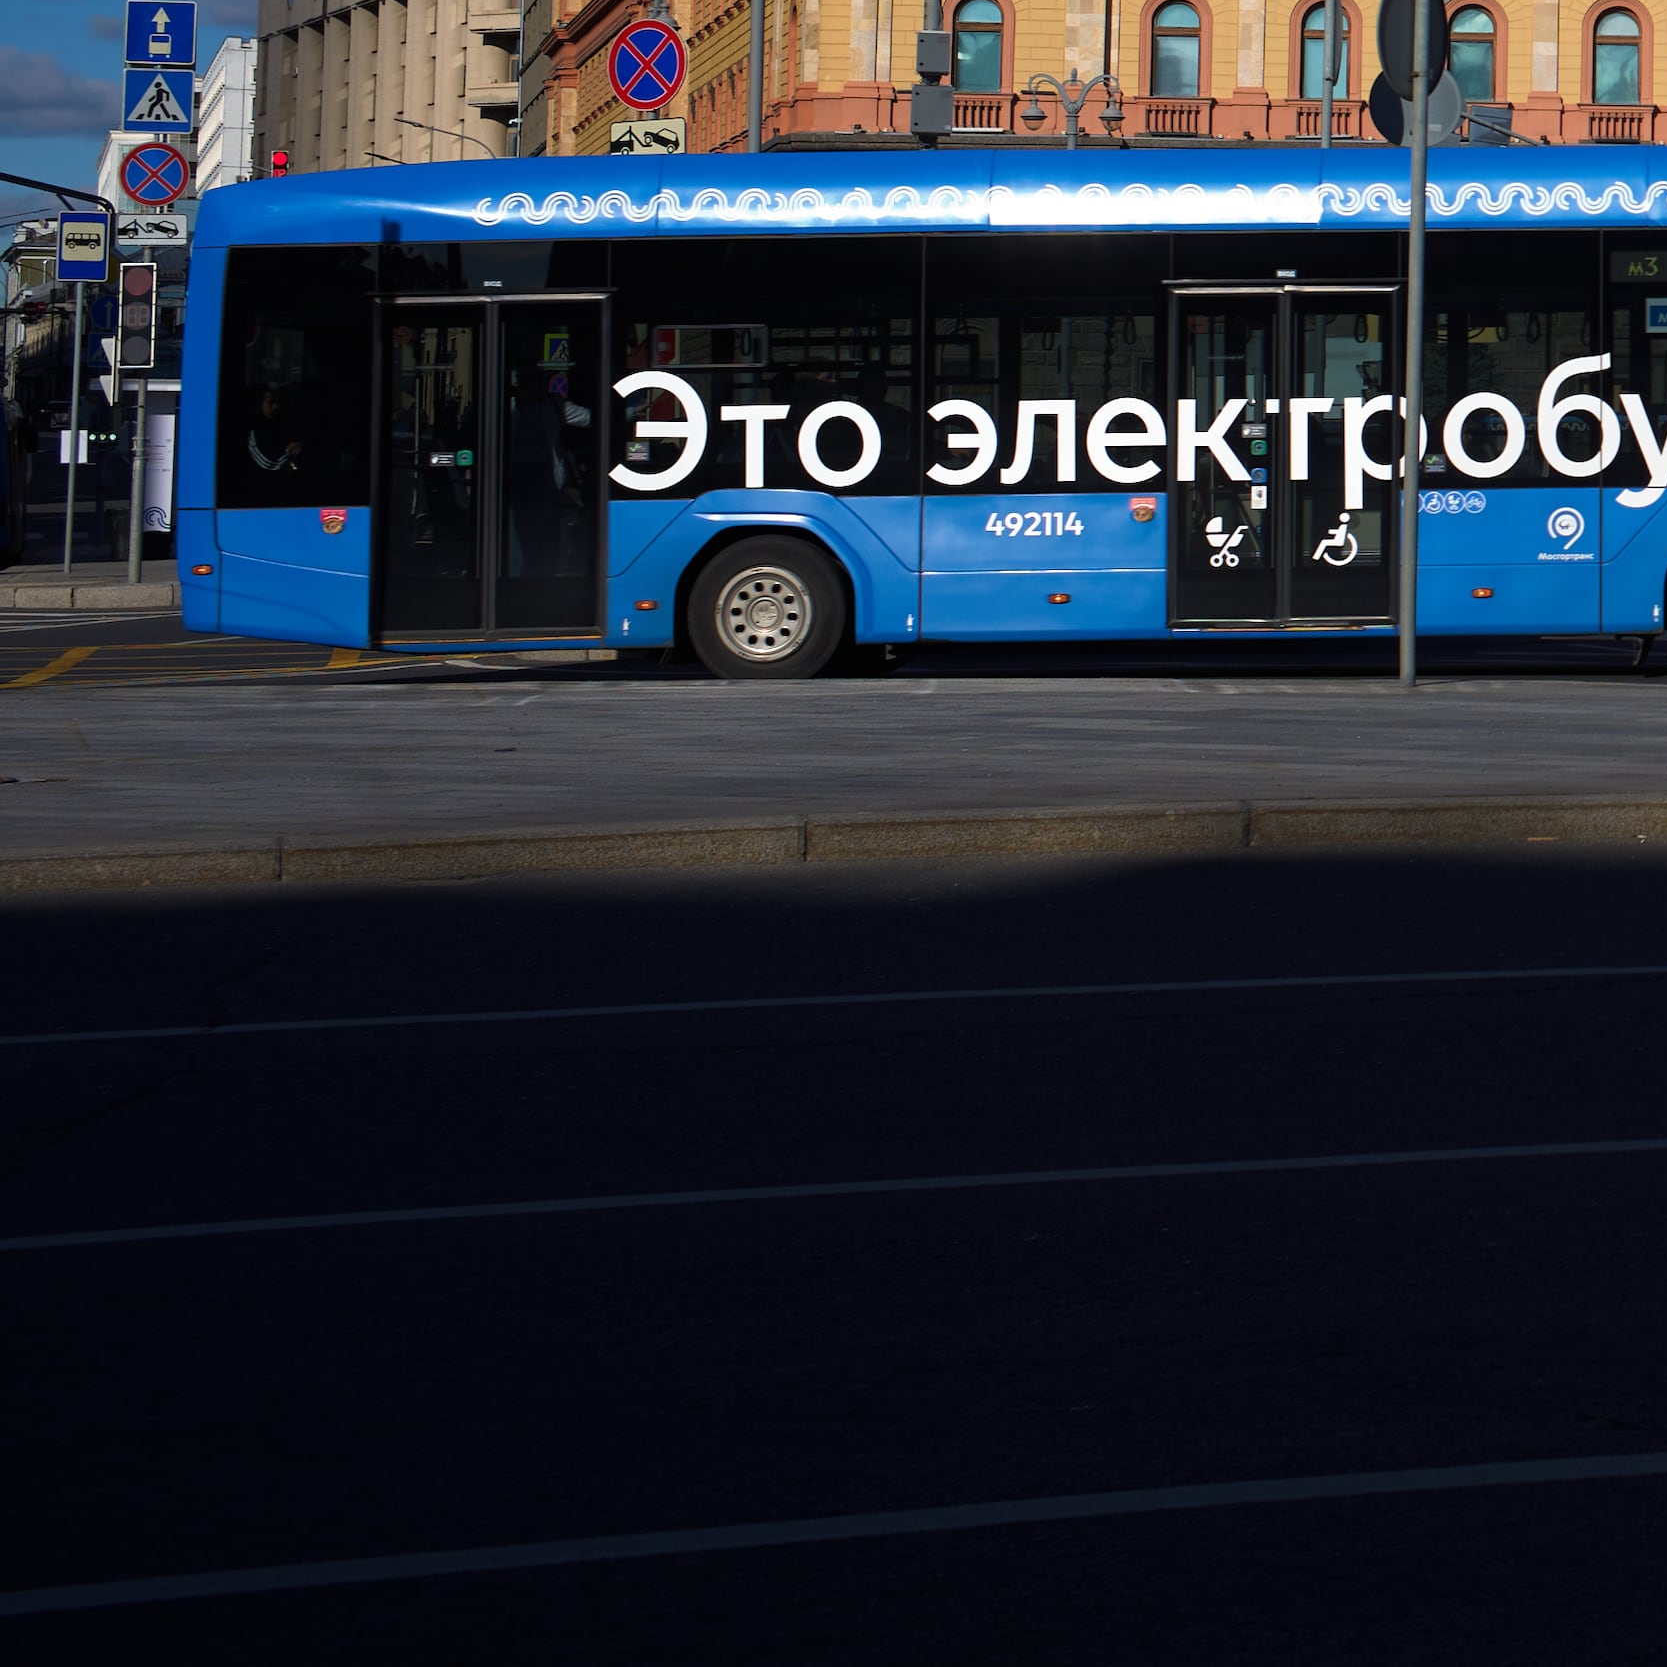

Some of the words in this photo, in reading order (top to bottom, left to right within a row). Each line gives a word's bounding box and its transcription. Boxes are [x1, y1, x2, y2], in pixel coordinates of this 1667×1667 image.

[1627, 257, 1659, 277] м3
[608, 370, 882, 491] Это
[985, 512, 1085, 538] 492114
